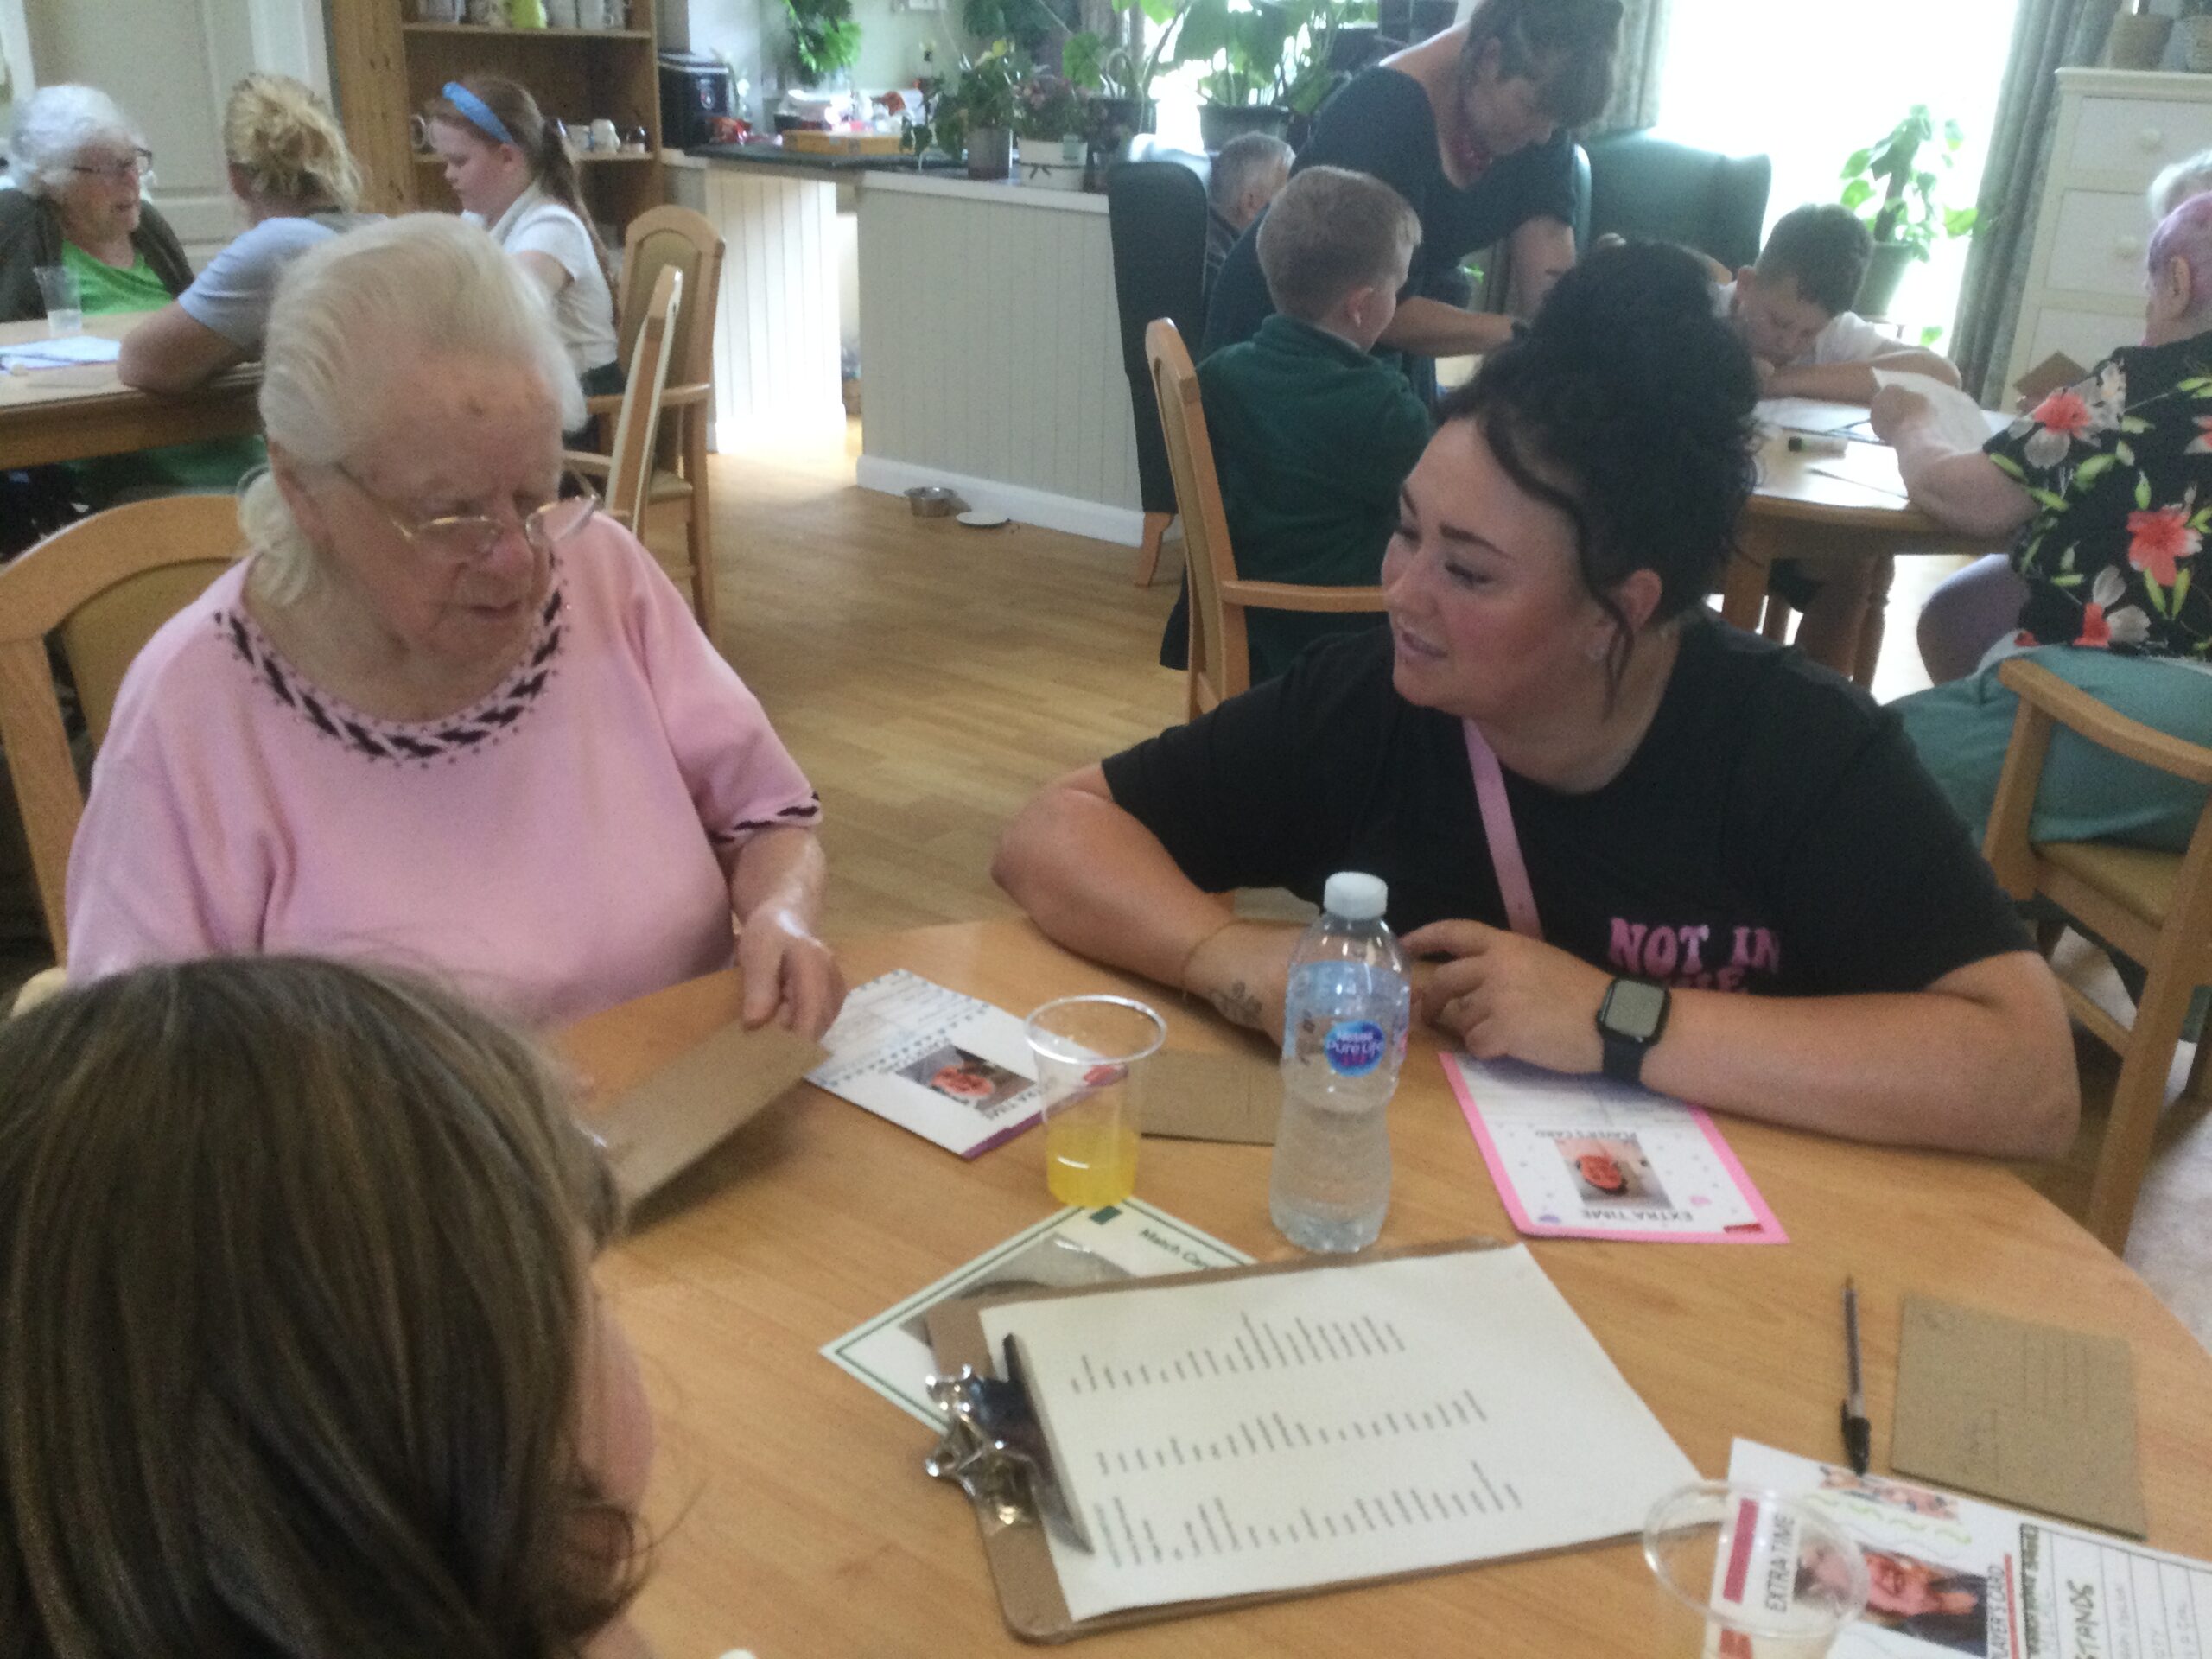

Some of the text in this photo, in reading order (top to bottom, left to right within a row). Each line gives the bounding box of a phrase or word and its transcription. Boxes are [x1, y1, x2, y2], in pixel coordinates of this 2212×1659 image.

[1608, 917, 1710, 979] NOT
[1731, 925, 1780, 972] IN
[1137, 1228, 1181, 1255] Match
[1582, 1210, 1694, 1222] EXTRA TIME
[1764, 1512, 1796, 1613] EXTRA TIME
[1987, 1565, 2009, 1659] LAYER'S CARD
